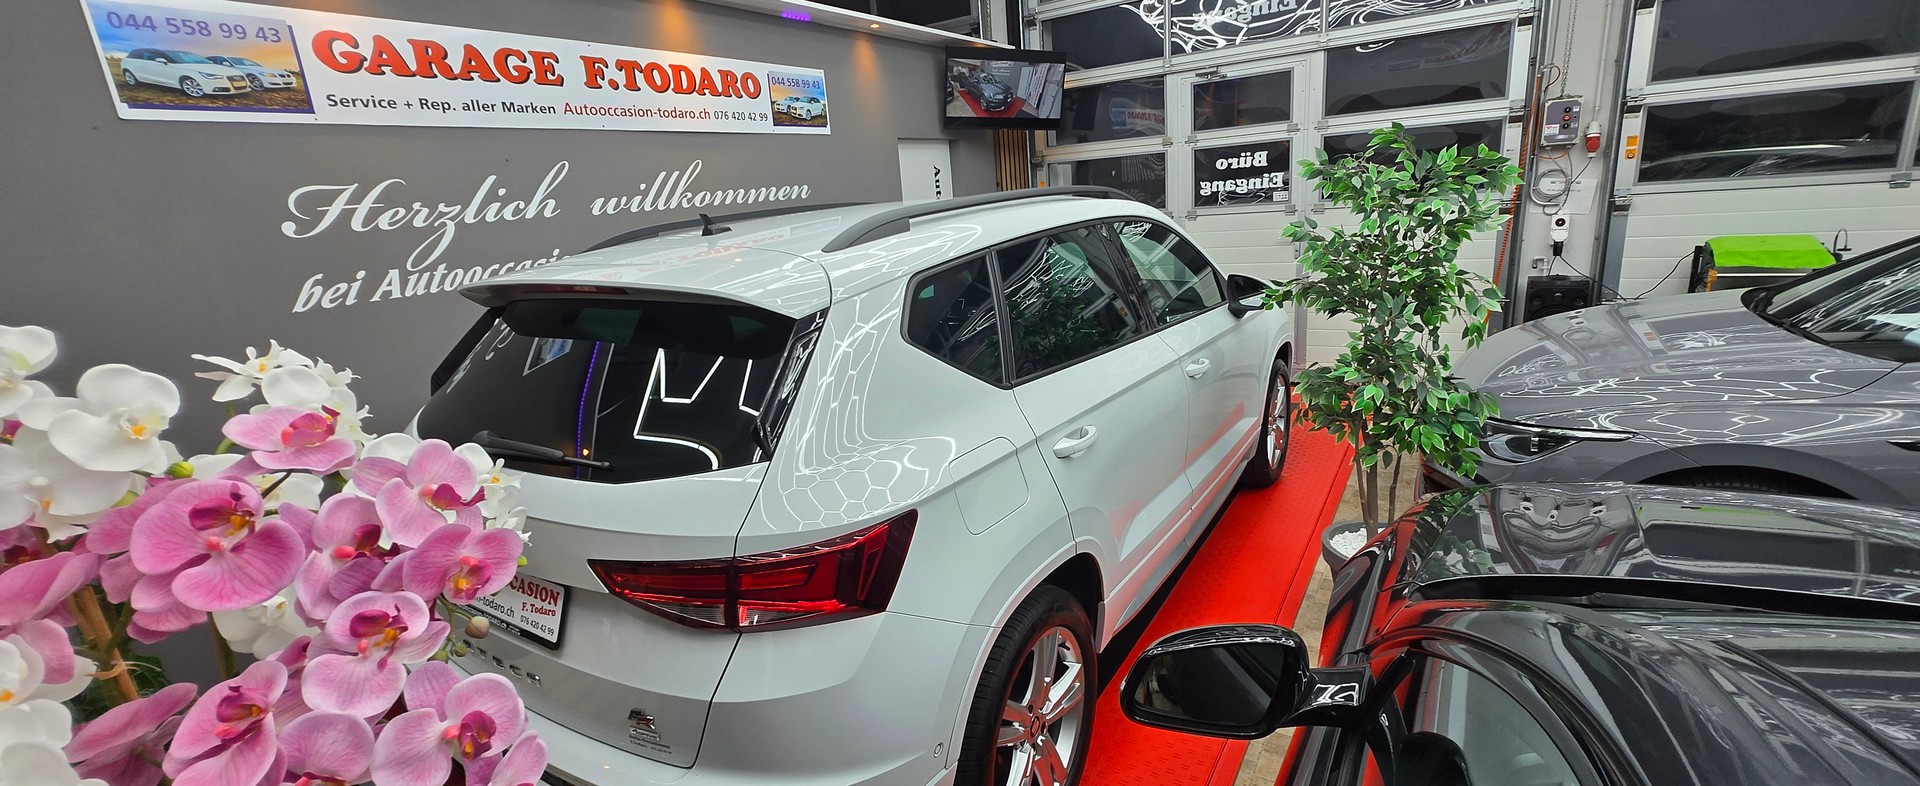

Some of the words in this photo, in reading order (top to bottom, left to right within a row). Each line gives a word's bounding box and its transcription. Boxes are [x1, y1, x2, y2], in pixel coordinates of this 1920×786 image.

[106, 11, 158, 32] 044
[164, 17, 212, 37] 558
[218, 22, 248, 40] 99
[255, 26, 282, 43] 43
[312, 29, 565, 87] GARAGE
[579, 54, 762, 99] F.TODARO
[771, 76, 785, 86] 044
[787, 77, 800, 88] 558
[801, 79, 811, 89] 99
[812, 80, 820, 90] 43
[326, 94, 398, 109] Service
[418, 97, 457, 114] Rep.
[462, 99, 497, 113] aller
[501, 101, 557, 114] Marken
[563, 102, 711, 120] Autooccasion-todaro.ch
[713, 110, 729, 121] 076
[731, 111, 746, 121] 420
[748, 112, 757, 122] 42
[758, 112, 768, 122] 99
[933, 165, 942, 200] Aut
[281, 160, 569, 271] Herzlich
[590, 159, 812, 216] willkommen
[292, 270, 366, 313] bei
[507, 574, 560, 608] CASION
[475, 596, 515, 619] n-todaro.ch
[521, 601, 529, 612] F.
[530, 603, 557, 617] Todaro
[530, 619, 540, 630] 420
[540, 624, 548, 634] 42
[547, 627, 555, 637] 99
